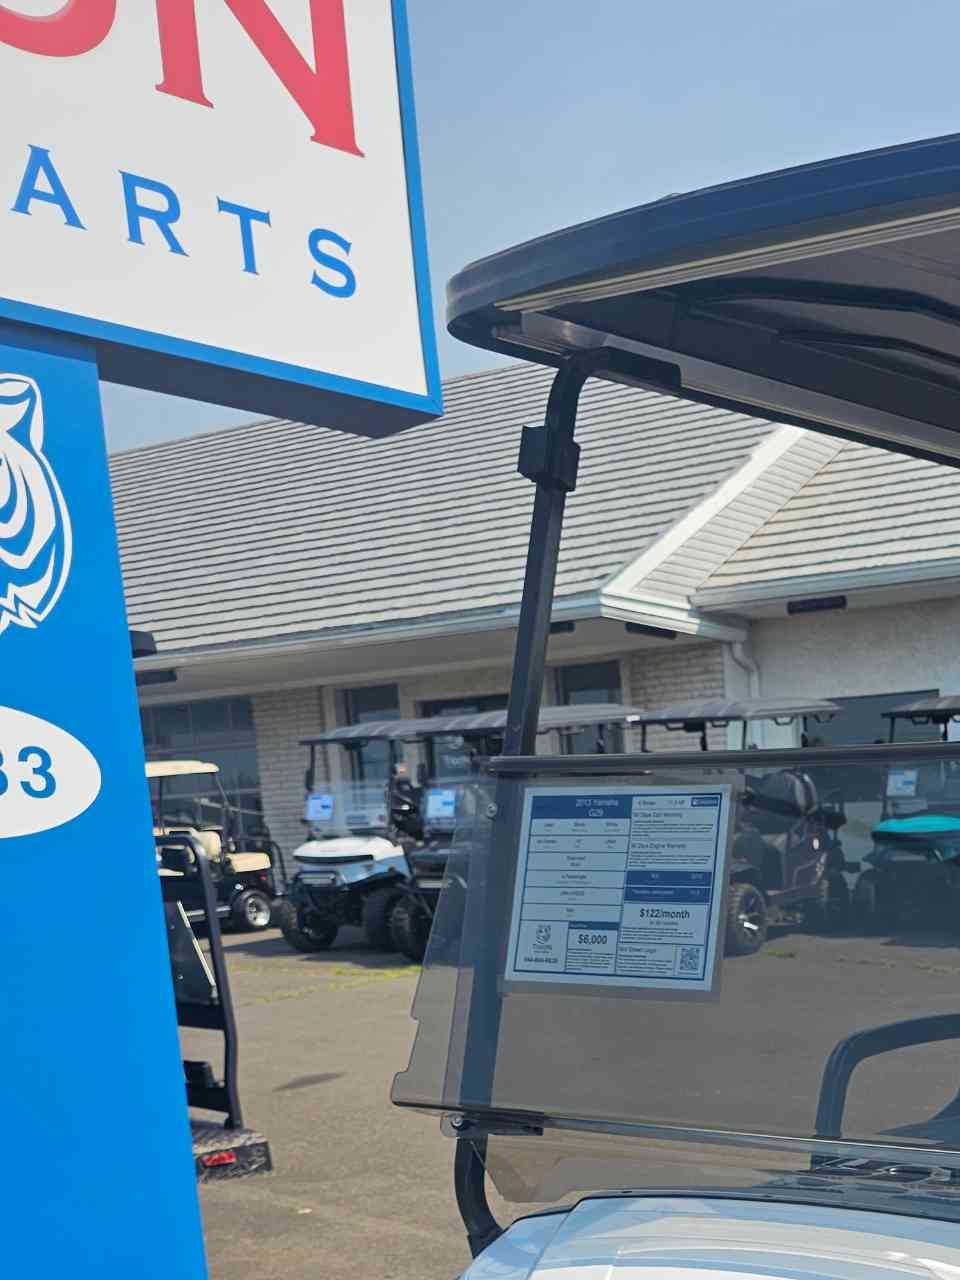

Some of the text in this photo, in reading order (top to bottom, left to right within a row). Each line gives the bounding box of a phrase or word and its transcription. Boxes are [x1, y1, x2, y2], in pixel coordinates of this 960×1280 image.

[0, 0, 366, 158] N
[10, 143, 358, 299] ARTS
[0, 745, 57, 799] 3
[577, 933, 608, 945] $6,000
[639, 908, 690, 919] $122/month
